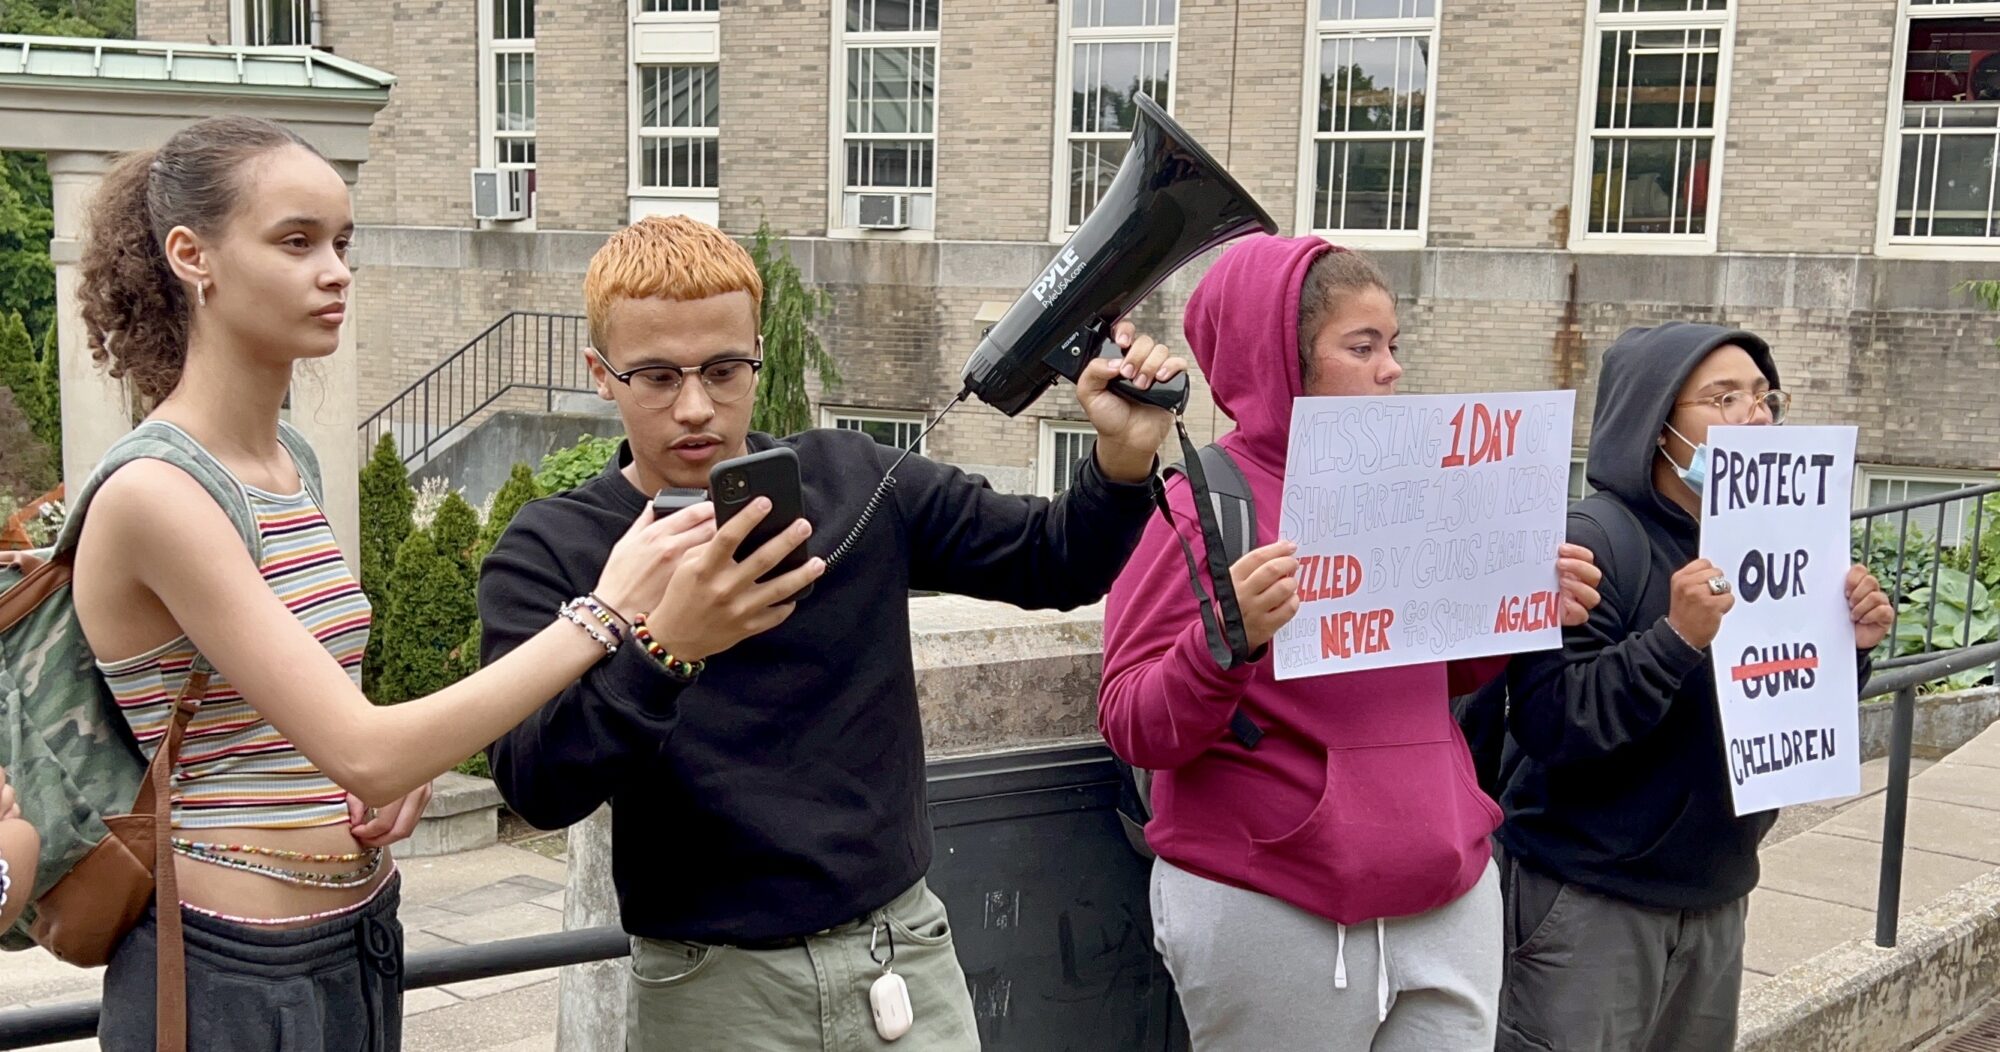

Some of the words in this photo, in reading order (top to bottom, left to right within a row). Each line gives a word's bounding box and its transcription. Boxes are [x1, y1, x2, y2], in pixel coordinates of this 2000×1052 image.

[1032, 246, 1079, 301] PYLE
[1042, 262, 1087, 309] PyleUSA.com
[1287, 401, 1443, 477] MISSING
[1526, 403, 1558, 455] OF
[1391, 479, 1429, 524] THE
[1426, 469, 1500, 532] 1300
[1505, 465, 1565, 516] KIDS
[1710, 447, 1835, 517] PROTECT
[1296, 555, 1362, 602] ILLED
[1368, 546, 1411, 594] BY
[1412, 533, 1482, 589] GUNS
[1485, 530, 1527, 575] EACH
[1738, 549, 1809, 603] OUR
[1320, 608, 1394, 659] NEVER
[1403, 600, 1429, 625] GO
[1403, 625, 1428, 648] TO
[1494, 591, 1560, 634] AGAIN
[1740, 642, 1818, 699] GUNS
[1730, 727, 1836, 786] CHILDREN
